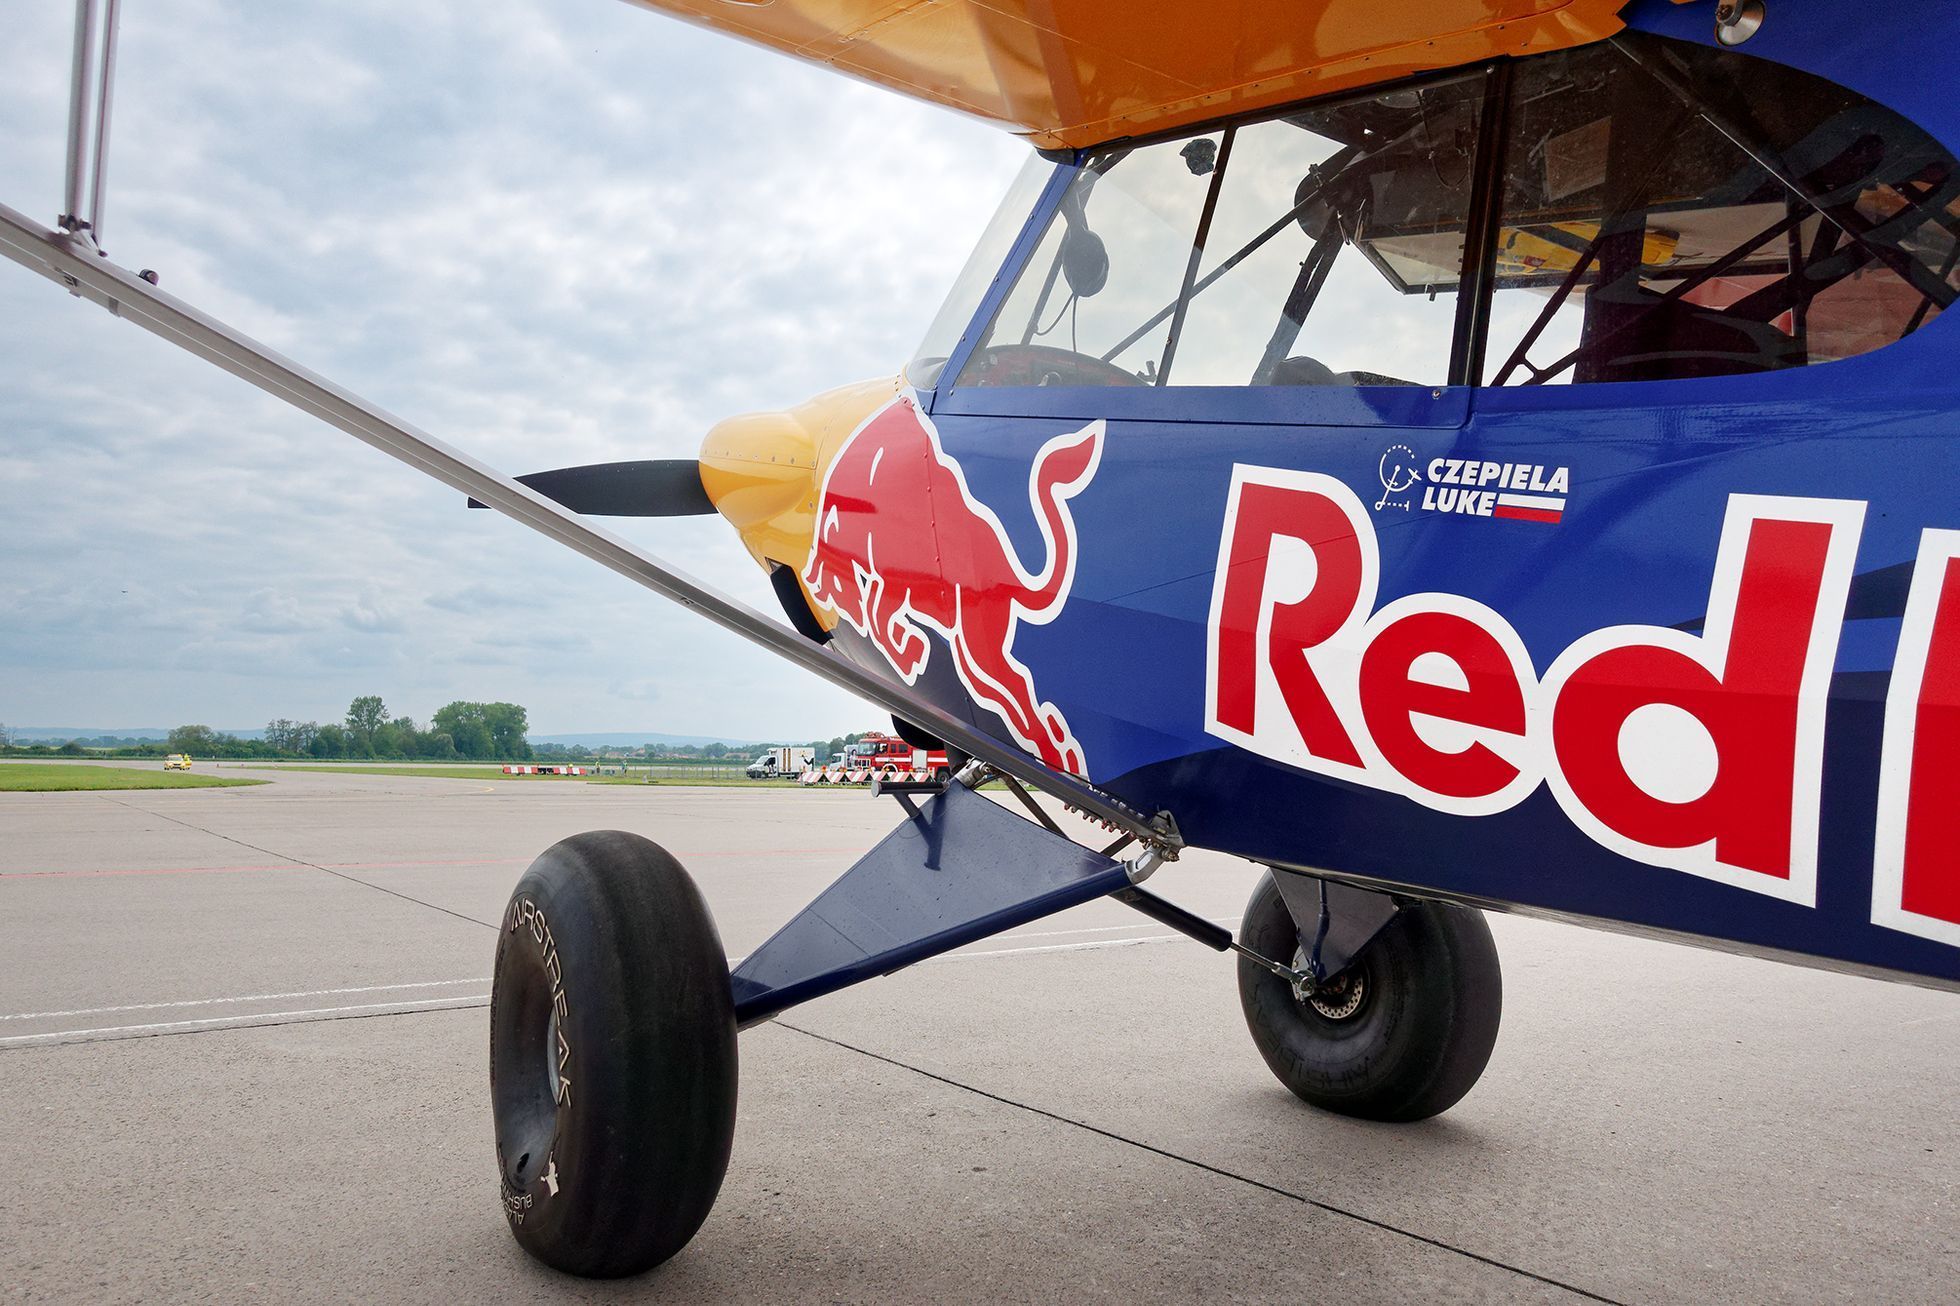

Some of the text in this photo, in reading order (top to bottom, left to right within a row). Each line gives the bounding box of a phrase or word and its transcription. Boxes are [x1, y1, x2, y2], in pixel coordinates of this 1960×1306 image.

[1421, 486, 1498, 517] LUKE
[1427, 458, 1569, 494] CZEPIELA
[1205, 464, 1868, 908] Red
[509, 897, 573, 1108] AIRSTREAK
